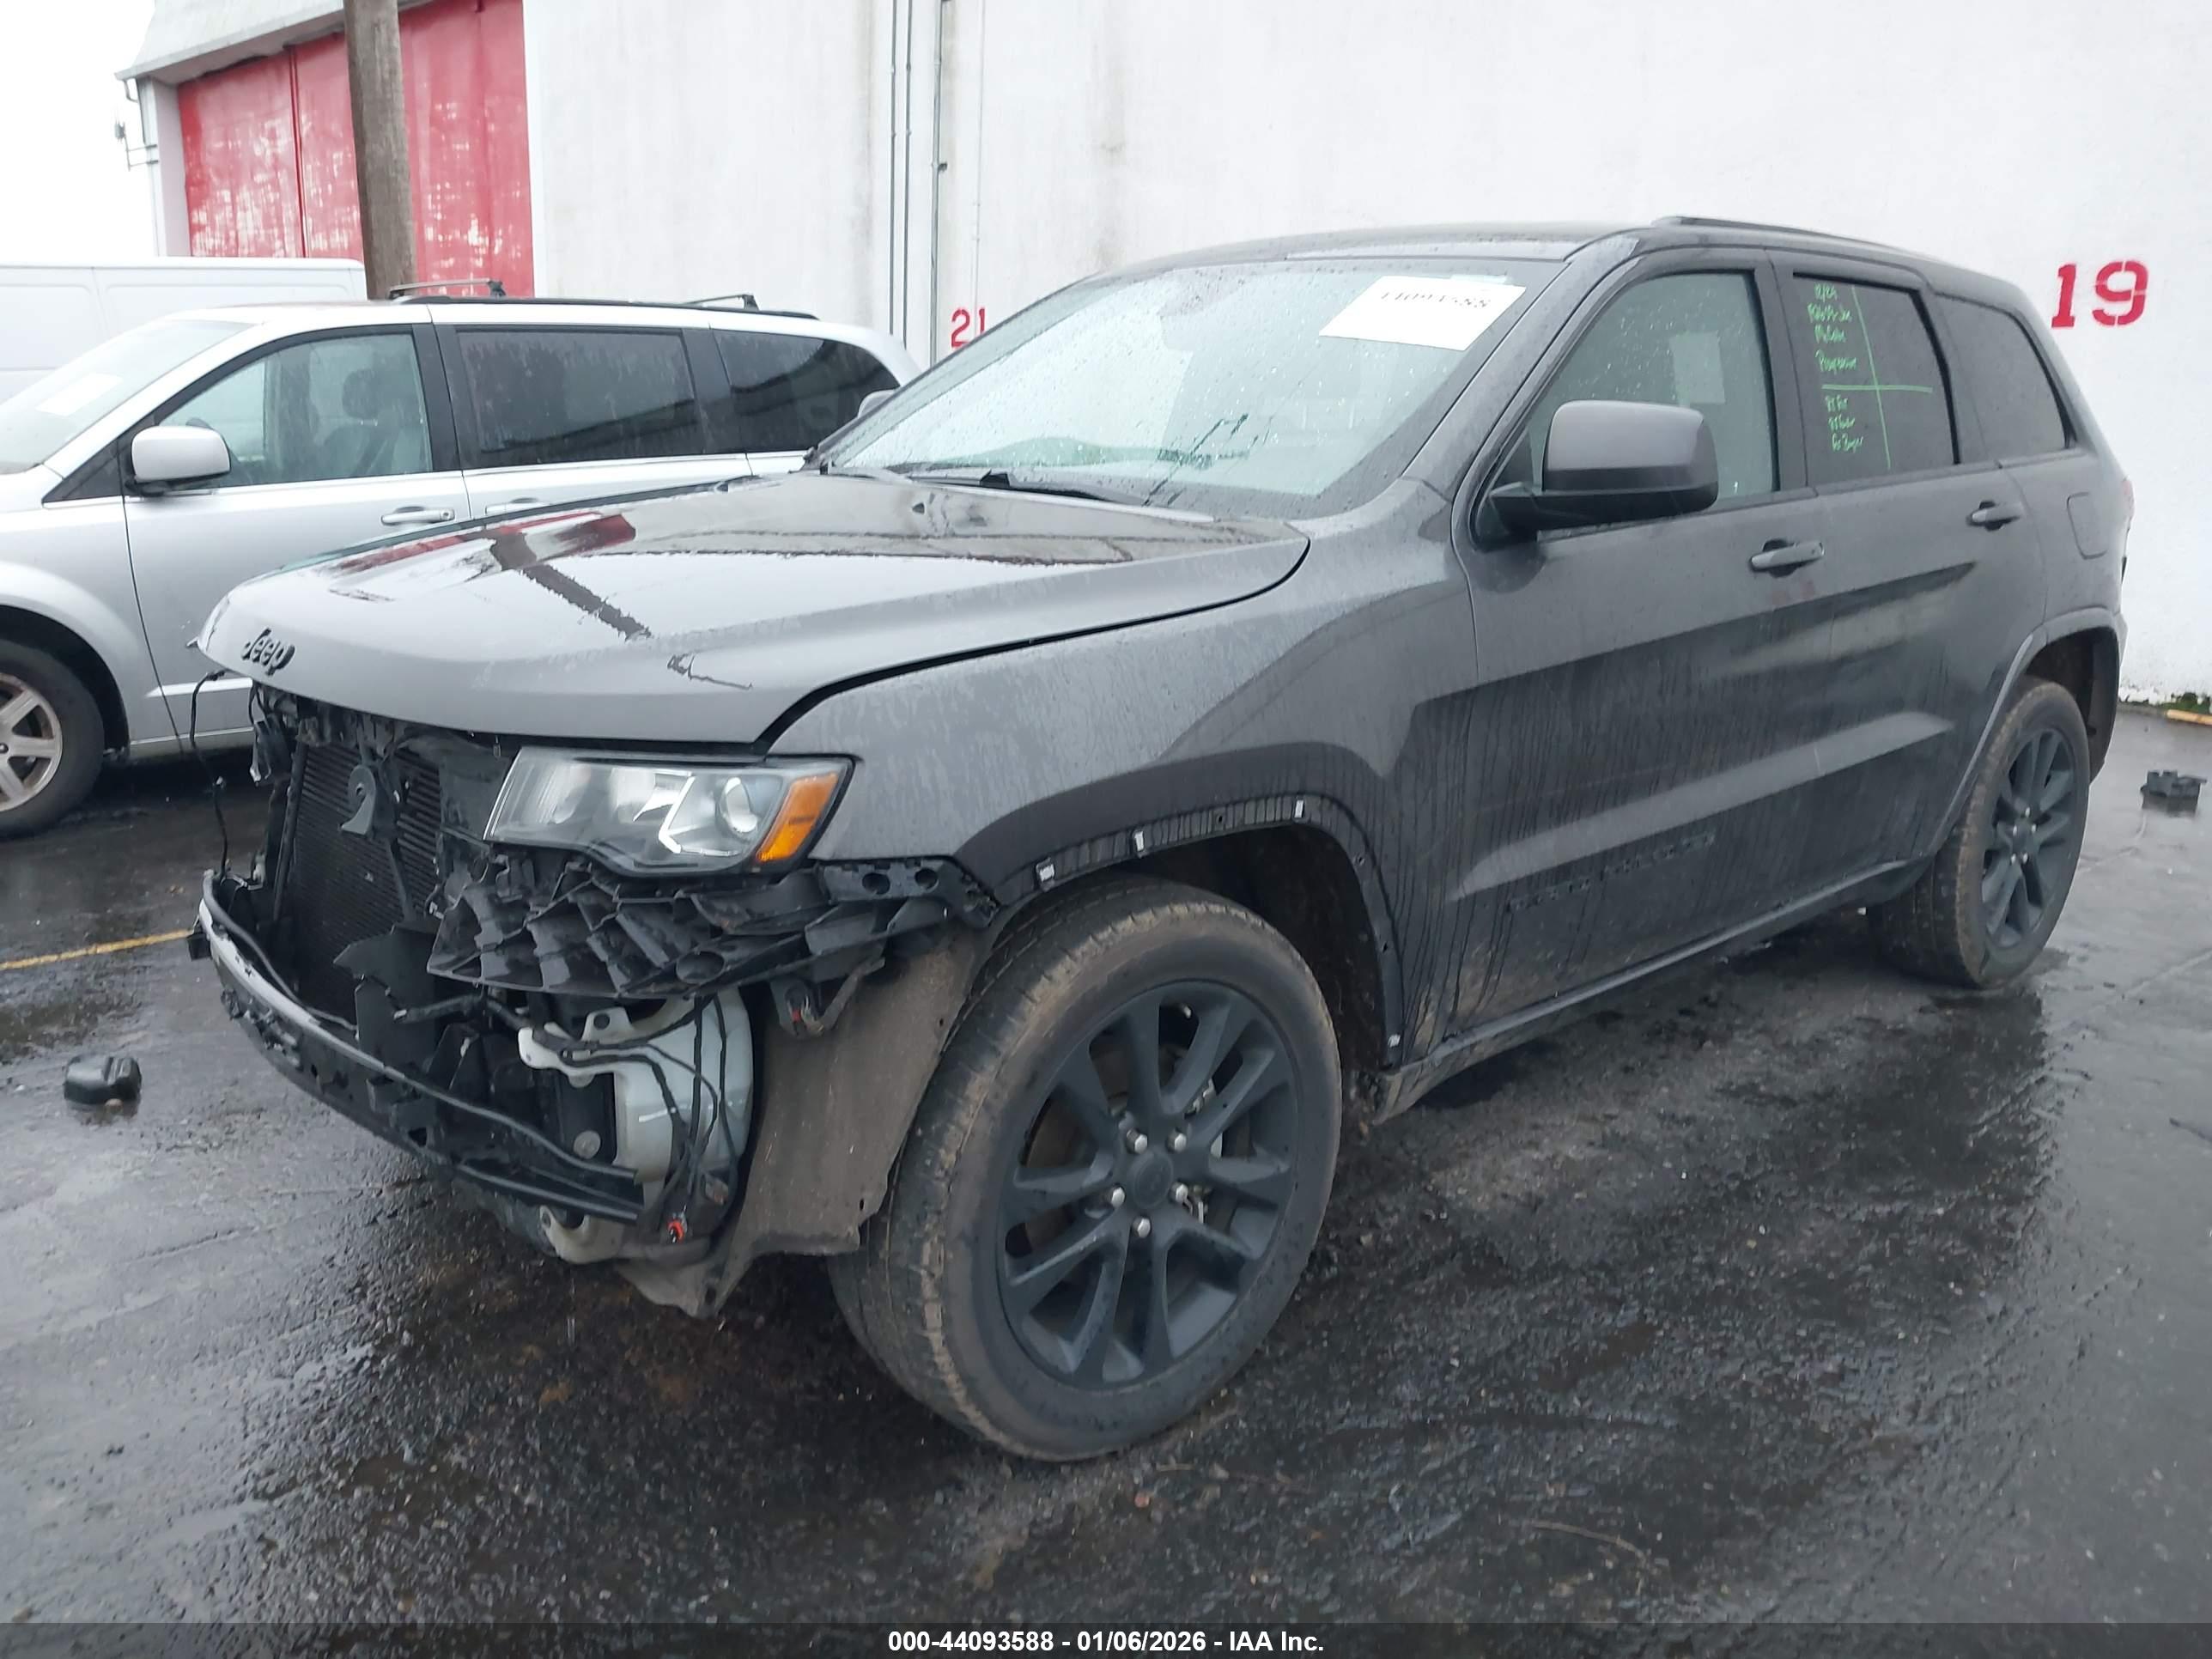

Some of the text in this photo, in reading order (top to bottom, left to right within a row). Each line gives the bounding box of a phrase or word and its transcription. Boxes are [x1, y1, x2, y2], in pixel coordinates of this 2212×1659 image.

[2051, 260, 2148, 328] 19
[951, 307, 986, 348] 21
[241, 626, 296, 677] Jeep
